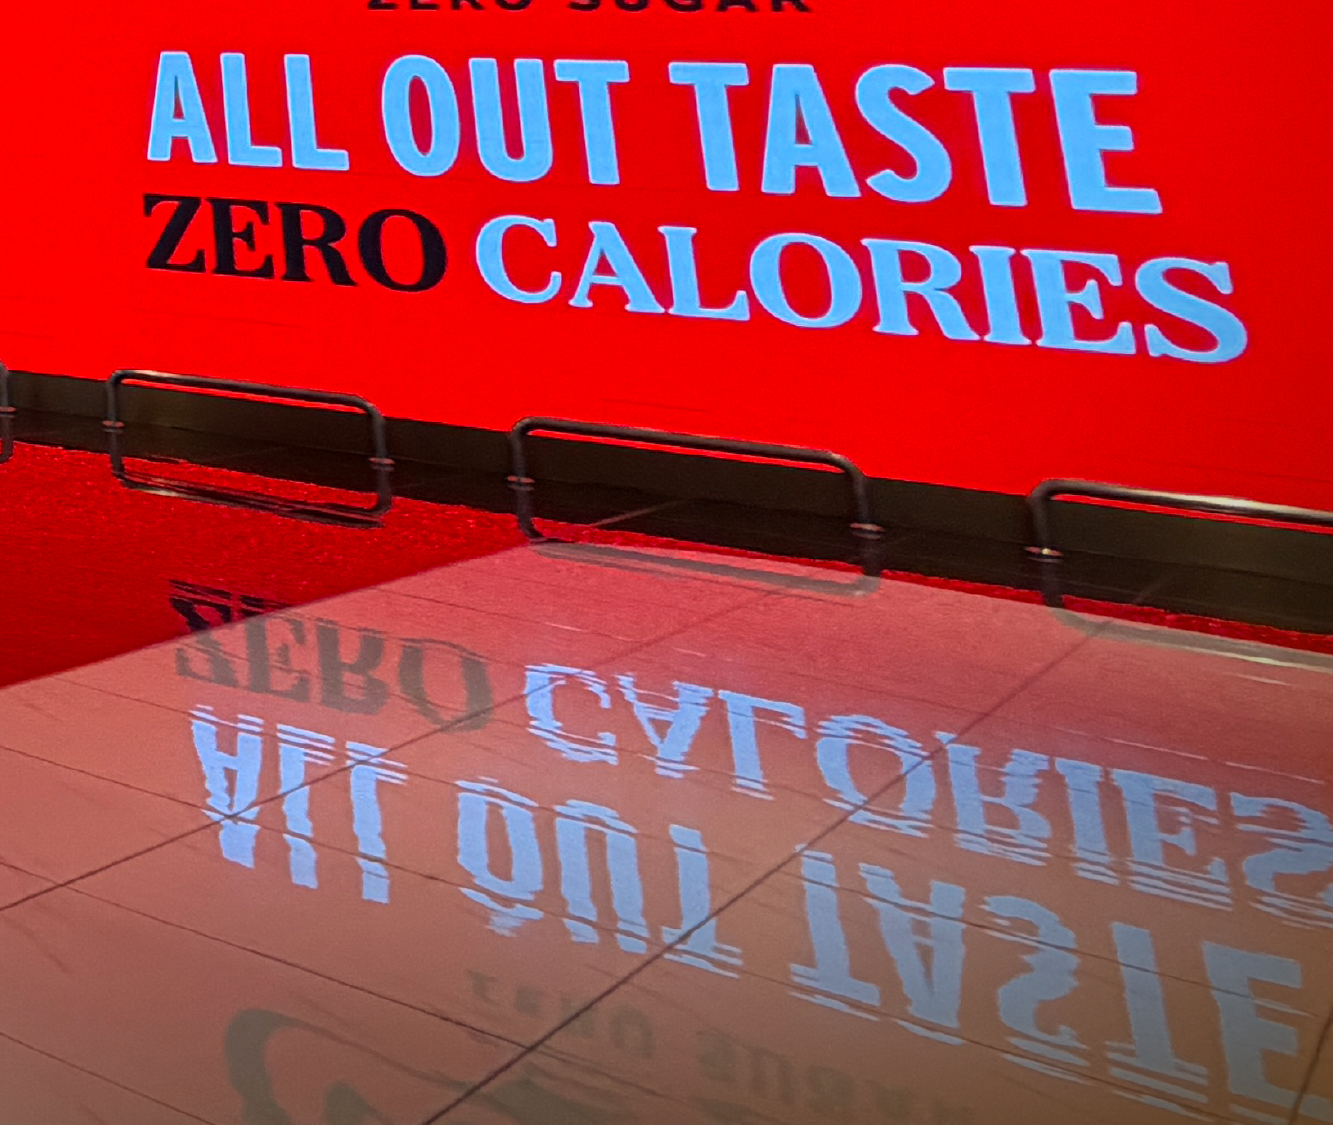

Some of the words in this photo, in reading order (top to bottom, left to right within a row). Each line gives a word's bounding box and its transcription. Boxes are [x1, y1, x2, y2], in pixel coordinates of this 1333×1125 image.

[146, 51, 350, 172] ALL
[381, 54, 631, 186] OUT
[667, 61, 1163, 215] TASTE
[141, 192, 449, 294] ZERO
[474, 214, 1249, 364] CALORIES
